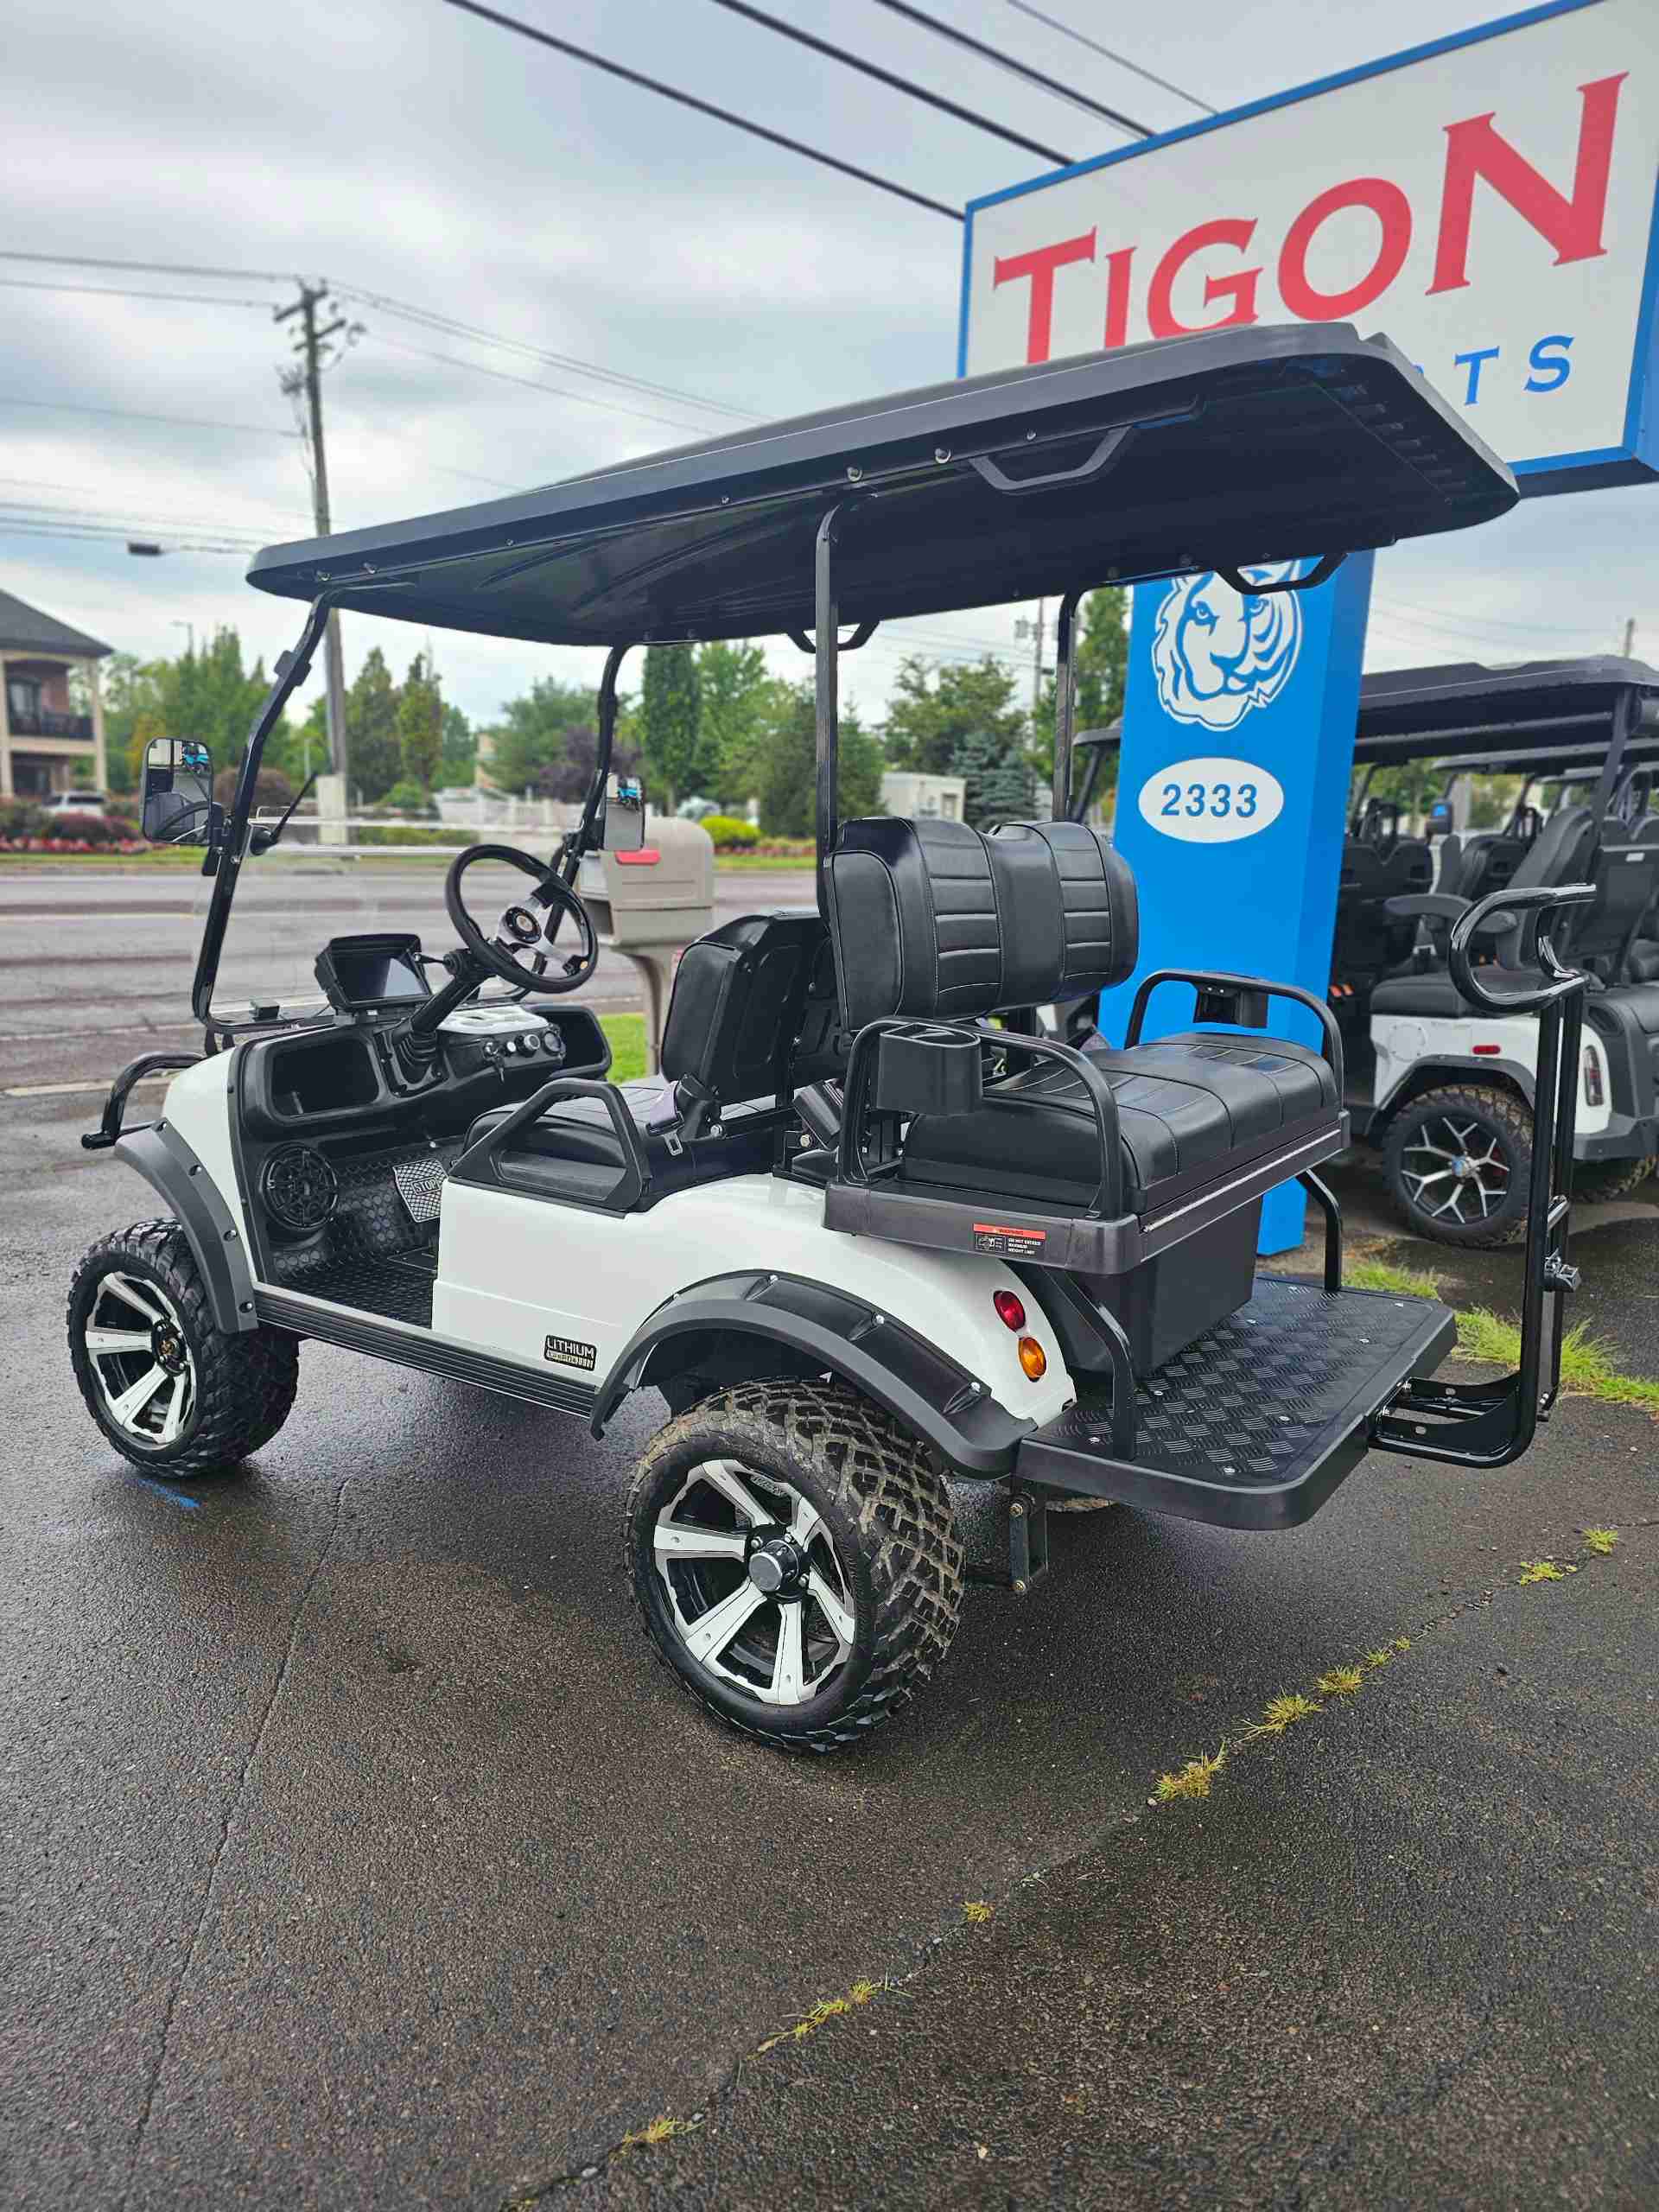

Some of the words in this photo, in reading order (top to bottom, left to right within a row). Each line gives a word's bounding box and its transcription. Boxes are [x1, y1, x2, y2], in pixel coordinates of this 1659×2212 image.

[994, 73, 1629, 364] TIGON
[1161, 784, 1257, 817] 2333
[414, 1179, 436, 1192] STOP
[547, 1337, 594, 1359] LITHIUM
